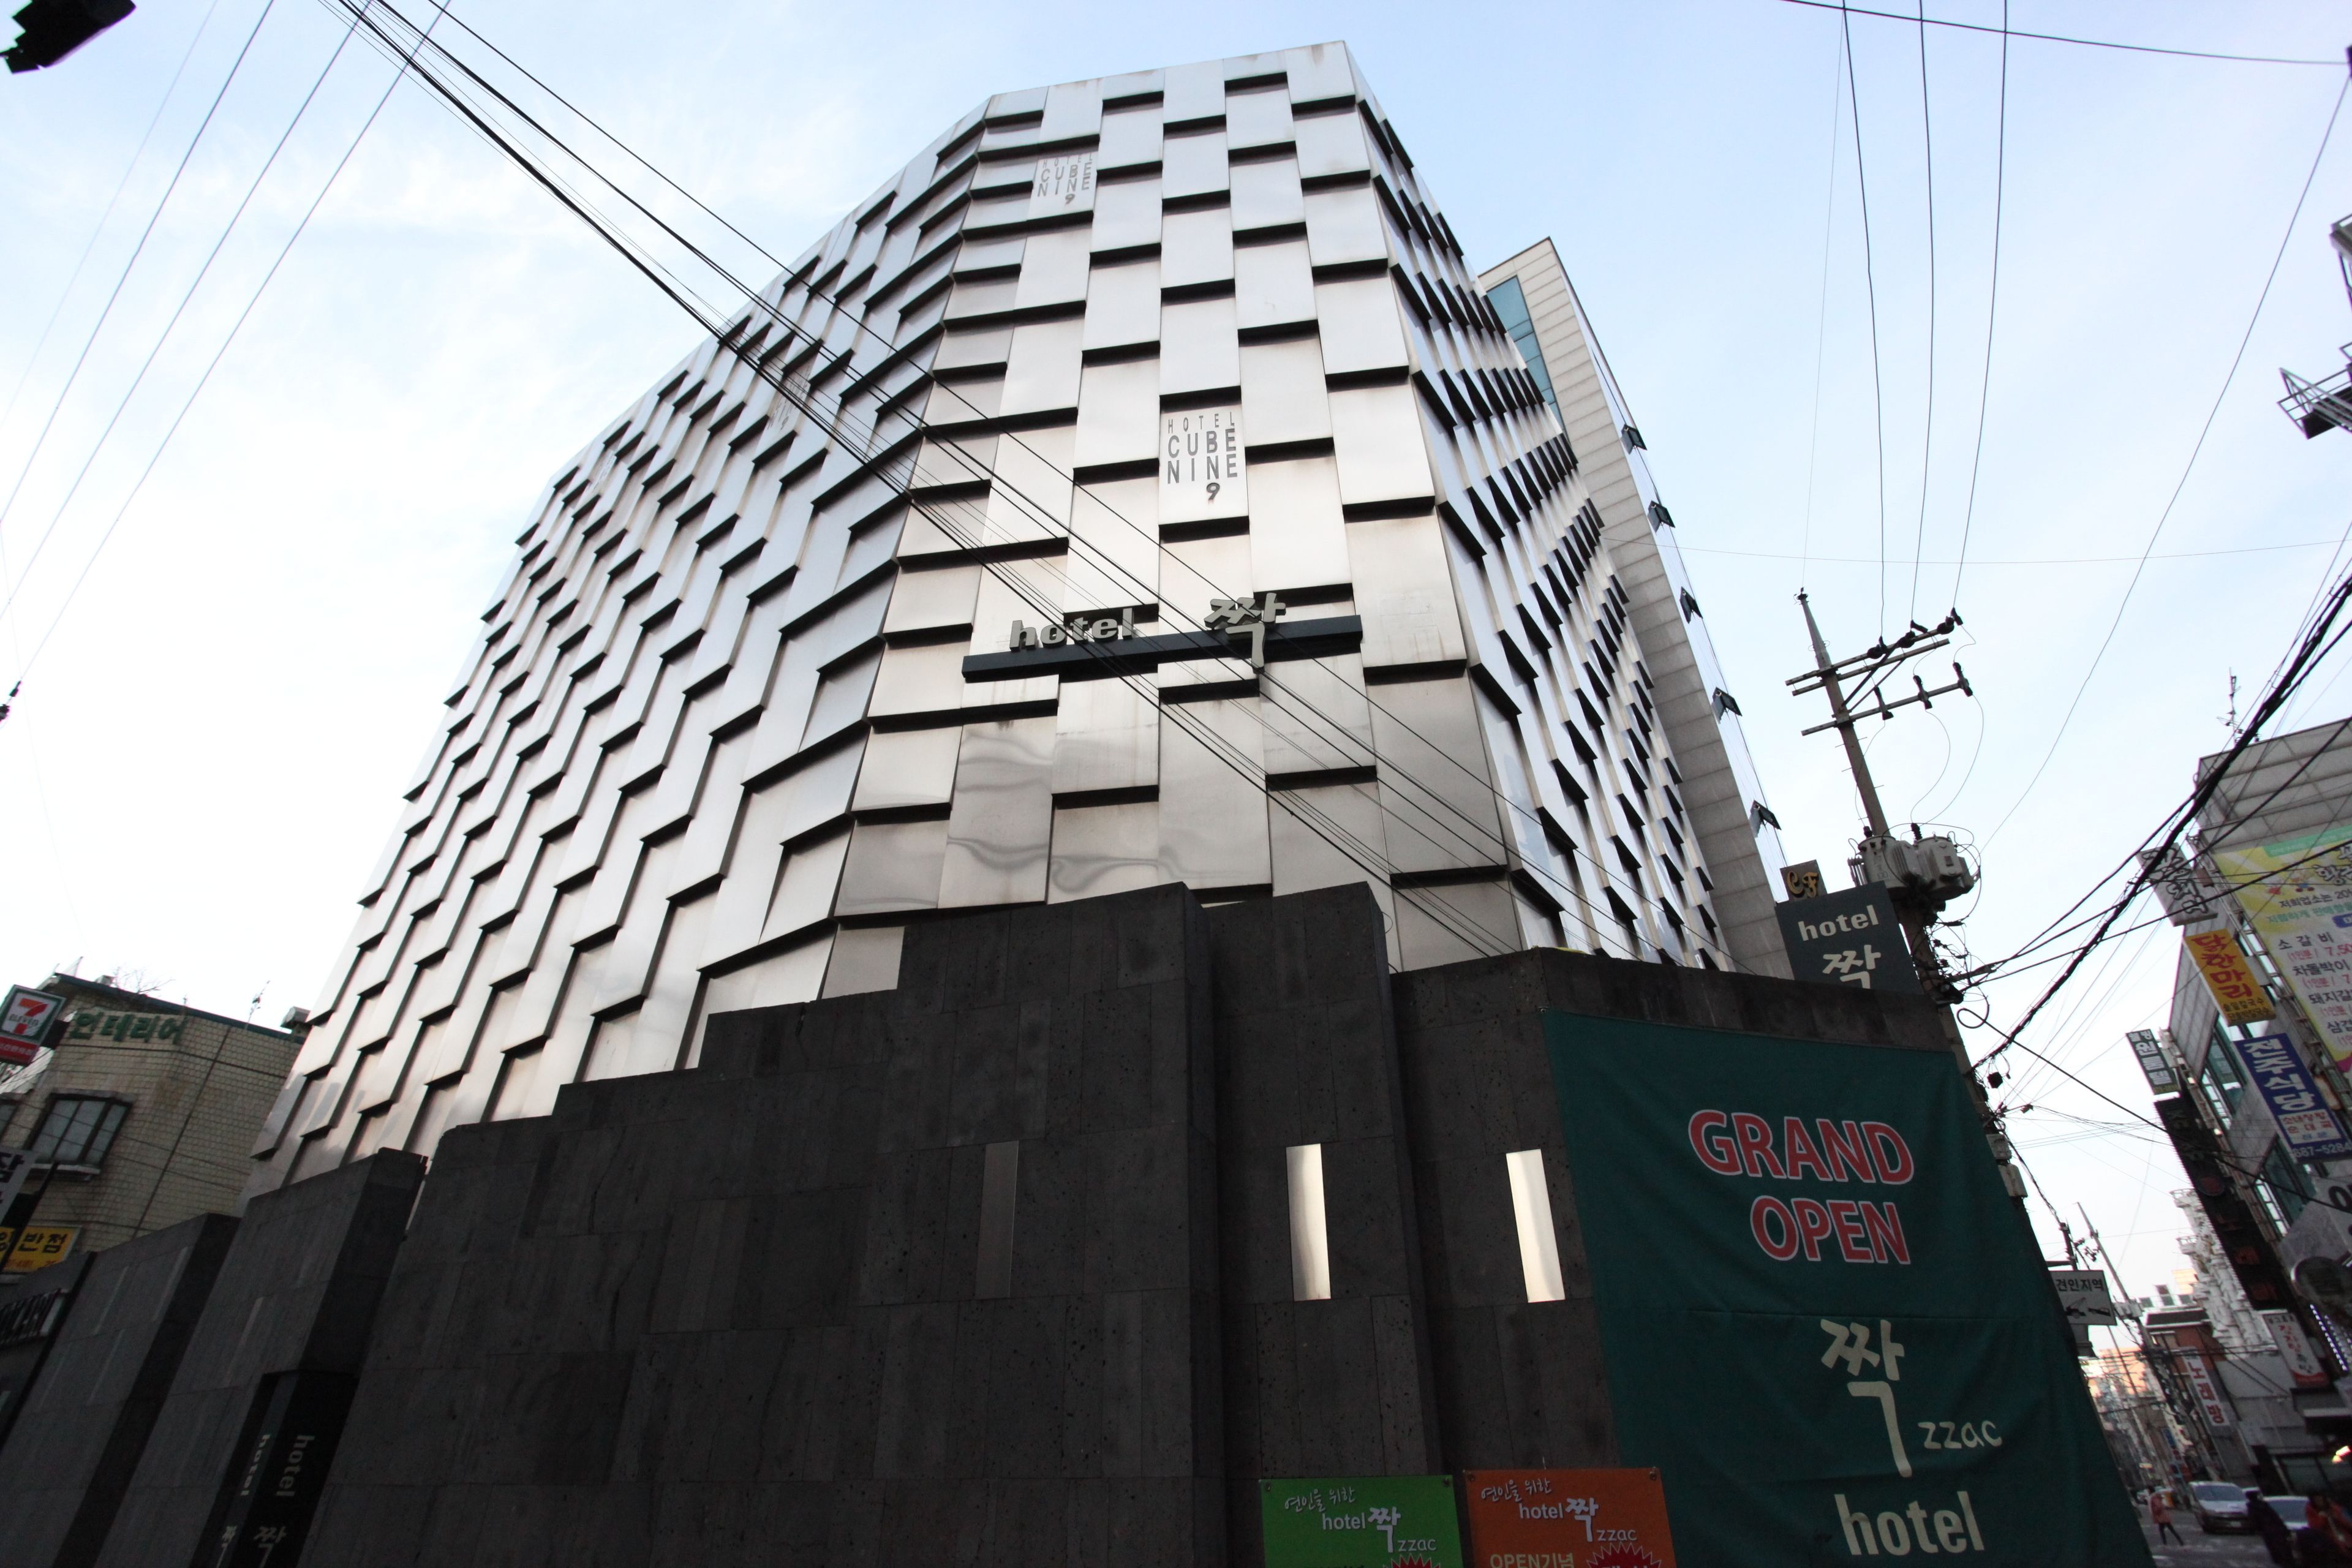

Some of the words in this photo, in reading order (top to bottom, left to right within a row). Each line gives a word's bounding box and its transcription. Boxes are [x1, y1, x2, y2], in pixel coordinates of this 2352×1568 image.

[1041, 162, 1093, 183] CUBE
[1042, 153, 1093, 168] HOTEL
[1037, 176, 1090, 197] NINE
[1065, 193, 1076, 205] 9
[1167, 411, 1235, 434] HOTEL
[1167, 428, 1237, 459] CUBE
[1167, 453, 1238, 484] NINE
[1206, 482, 1221, 501] 9
[1009, 608, 1134, 652] hotel
[1203, 592, 1286, 674] 짝
[1798, 905, 1879, 941] hotel
[1822, 944, 1882, 989] 짝
[2293, 959, 2351, 976] 차돌박이
[2308, 989, 2352, 1005] 돼지갈
[69, 1011, 189, 1045] 인테리어
[2244, 1038, 2315, 1111] 전주식당
[1688, 1109, 1915, 1185] GRAND
[1750, 1196, 1911, 1265] OPEN
[2055, 1278, 2105, 1292] 견인지역
[1820, 1319, 1912, 1477] 짝
[1918, 1420, 2003, 1449] zzac
[276, 1434, 315, 1496] hotel
[1285, 1489, 1326, 1512] 연인을
[1329, 1487, 1356, 1505] 위한
[1481, 1479, 1523, 1501] 연인을
[1525, 1477, 1551, 1495] 위한
[1322, 1512, 1366, 1530] hotel
[1368, 1506, 1401, 1553] 짝
[1519, 1502, 1564, 1520] hotel
[1565, 1497, 1599, 1542] 짝
[1834, 1491, 1985, 1557] hotel
[1398, 1539, 1437, 1553] zzac
[1597, 1529, 1637, 1542] zzac
